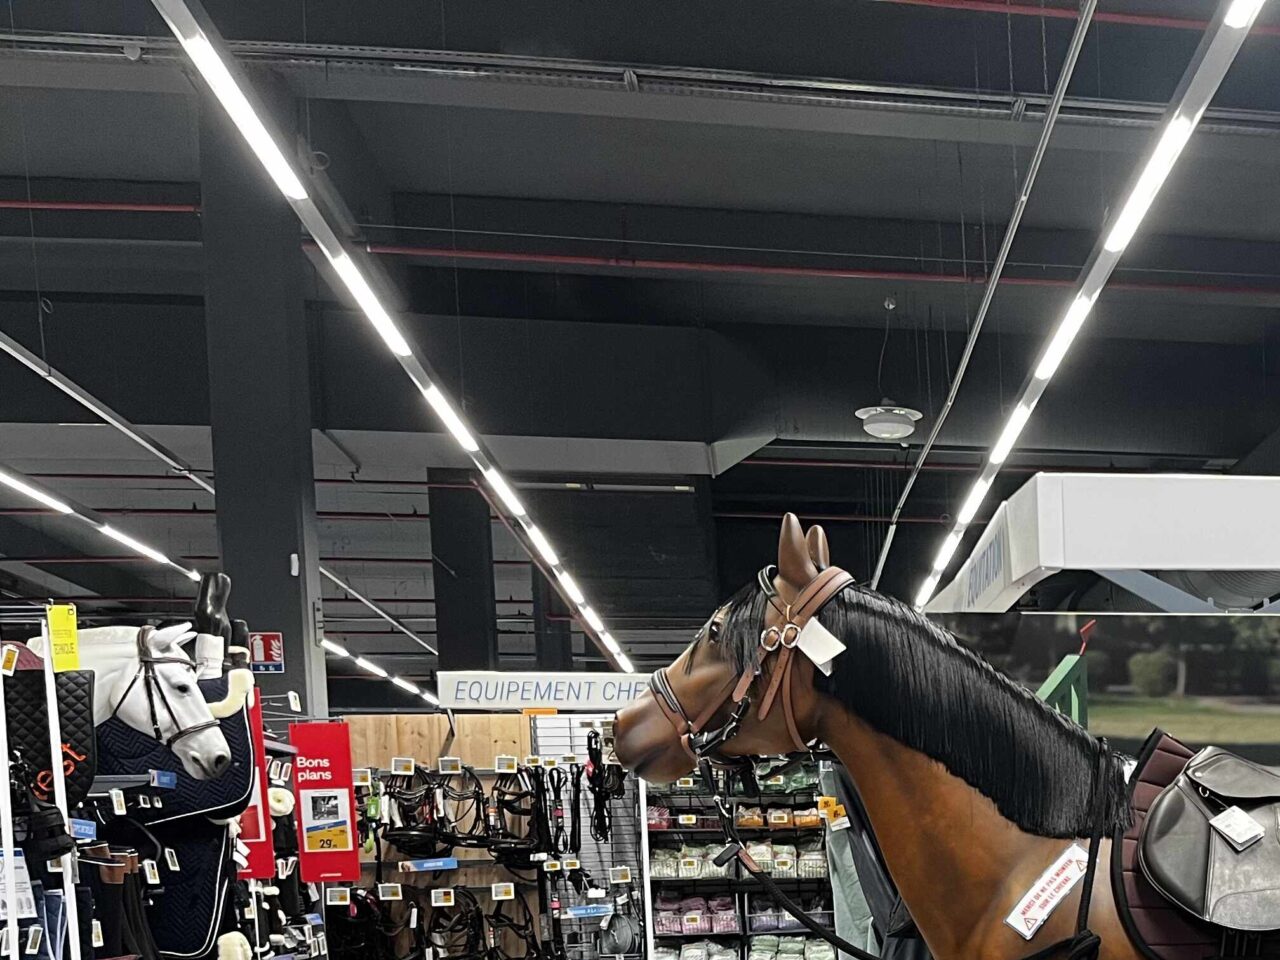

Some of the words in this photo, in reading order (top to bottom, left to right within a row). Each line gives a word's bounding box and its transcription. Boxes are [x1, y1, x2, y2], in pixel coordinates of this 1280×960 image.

[454, 680, 597, 704] EQUIPEMENT
[602, 681, 650, 701] CHE
[296, 756, 330, 768] Bons
[298, 769, 332, 783] plans
